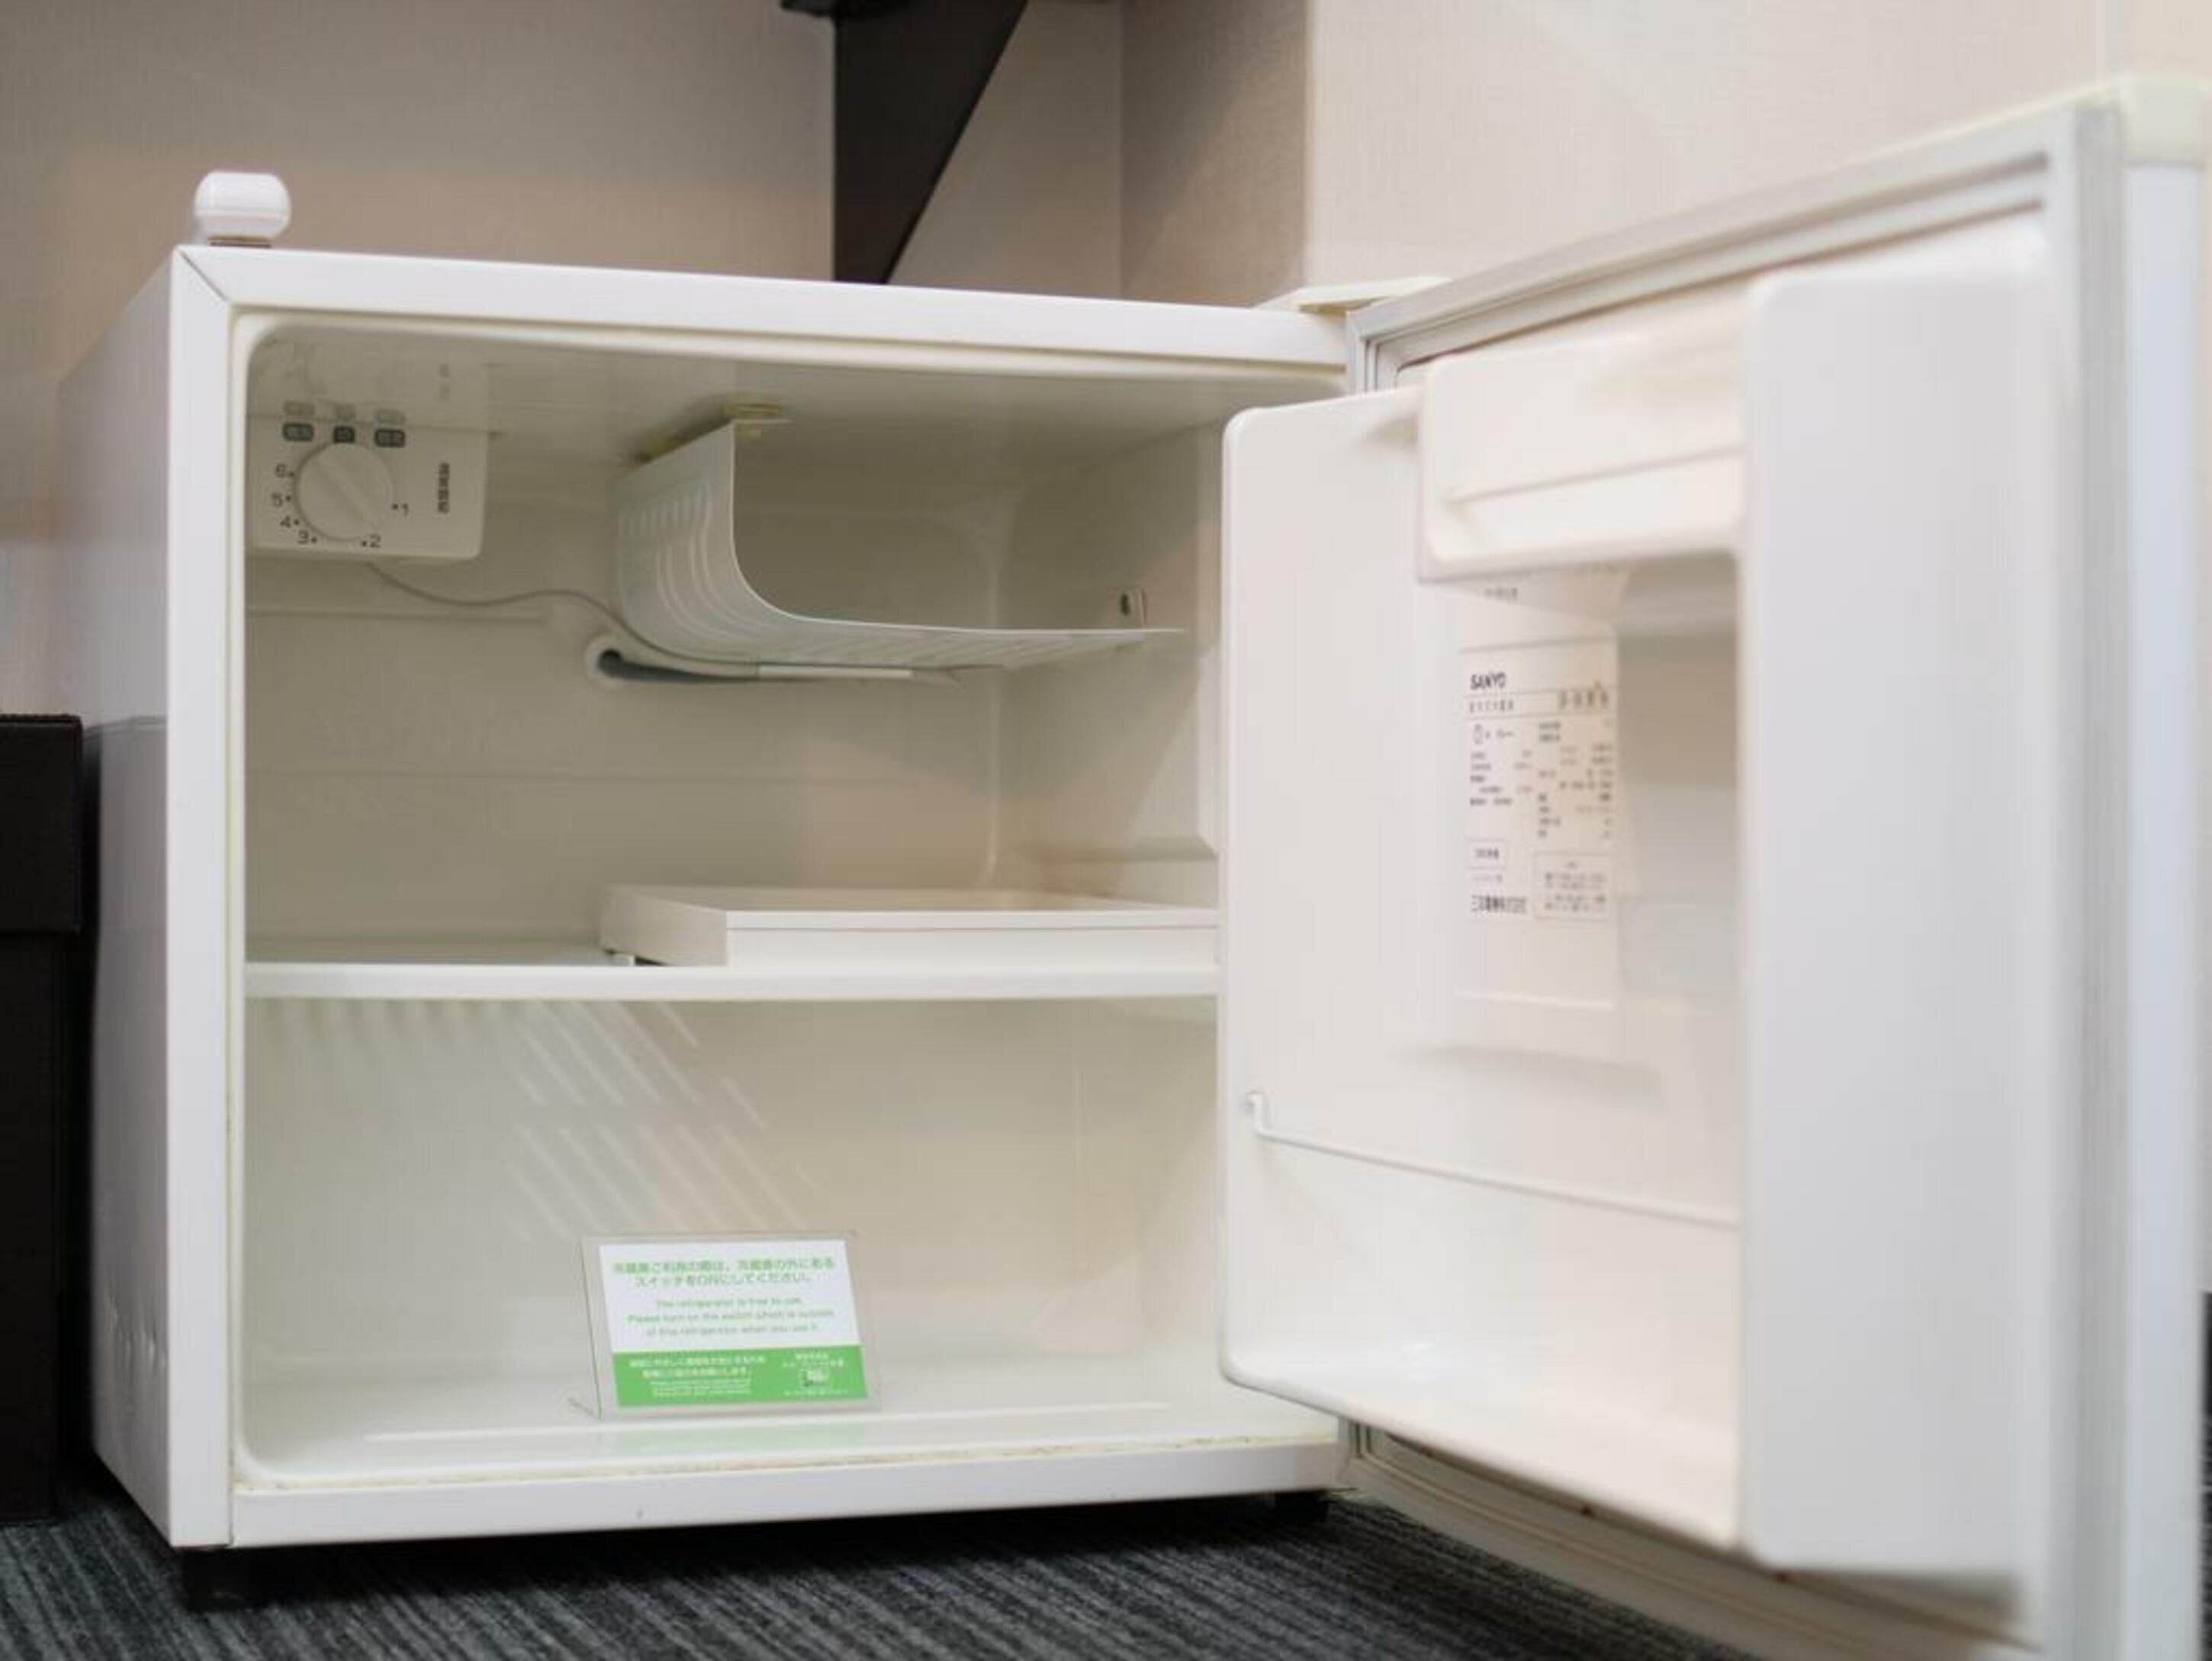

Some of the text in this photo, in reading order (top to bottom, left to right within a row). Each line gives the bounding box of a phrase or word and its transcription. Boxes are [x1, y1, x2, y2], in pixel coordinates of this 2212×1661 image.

[275, 464, 286, 478] 6
[272, 492, 283, 507] 5
[401, 504, 409, 517] 1
[280, 516, 291, 527] 4
[297, 530, 309, 544] 3
[369, 534, 381, 548] 2
[1471, 671, 1506, 690] SANYO
